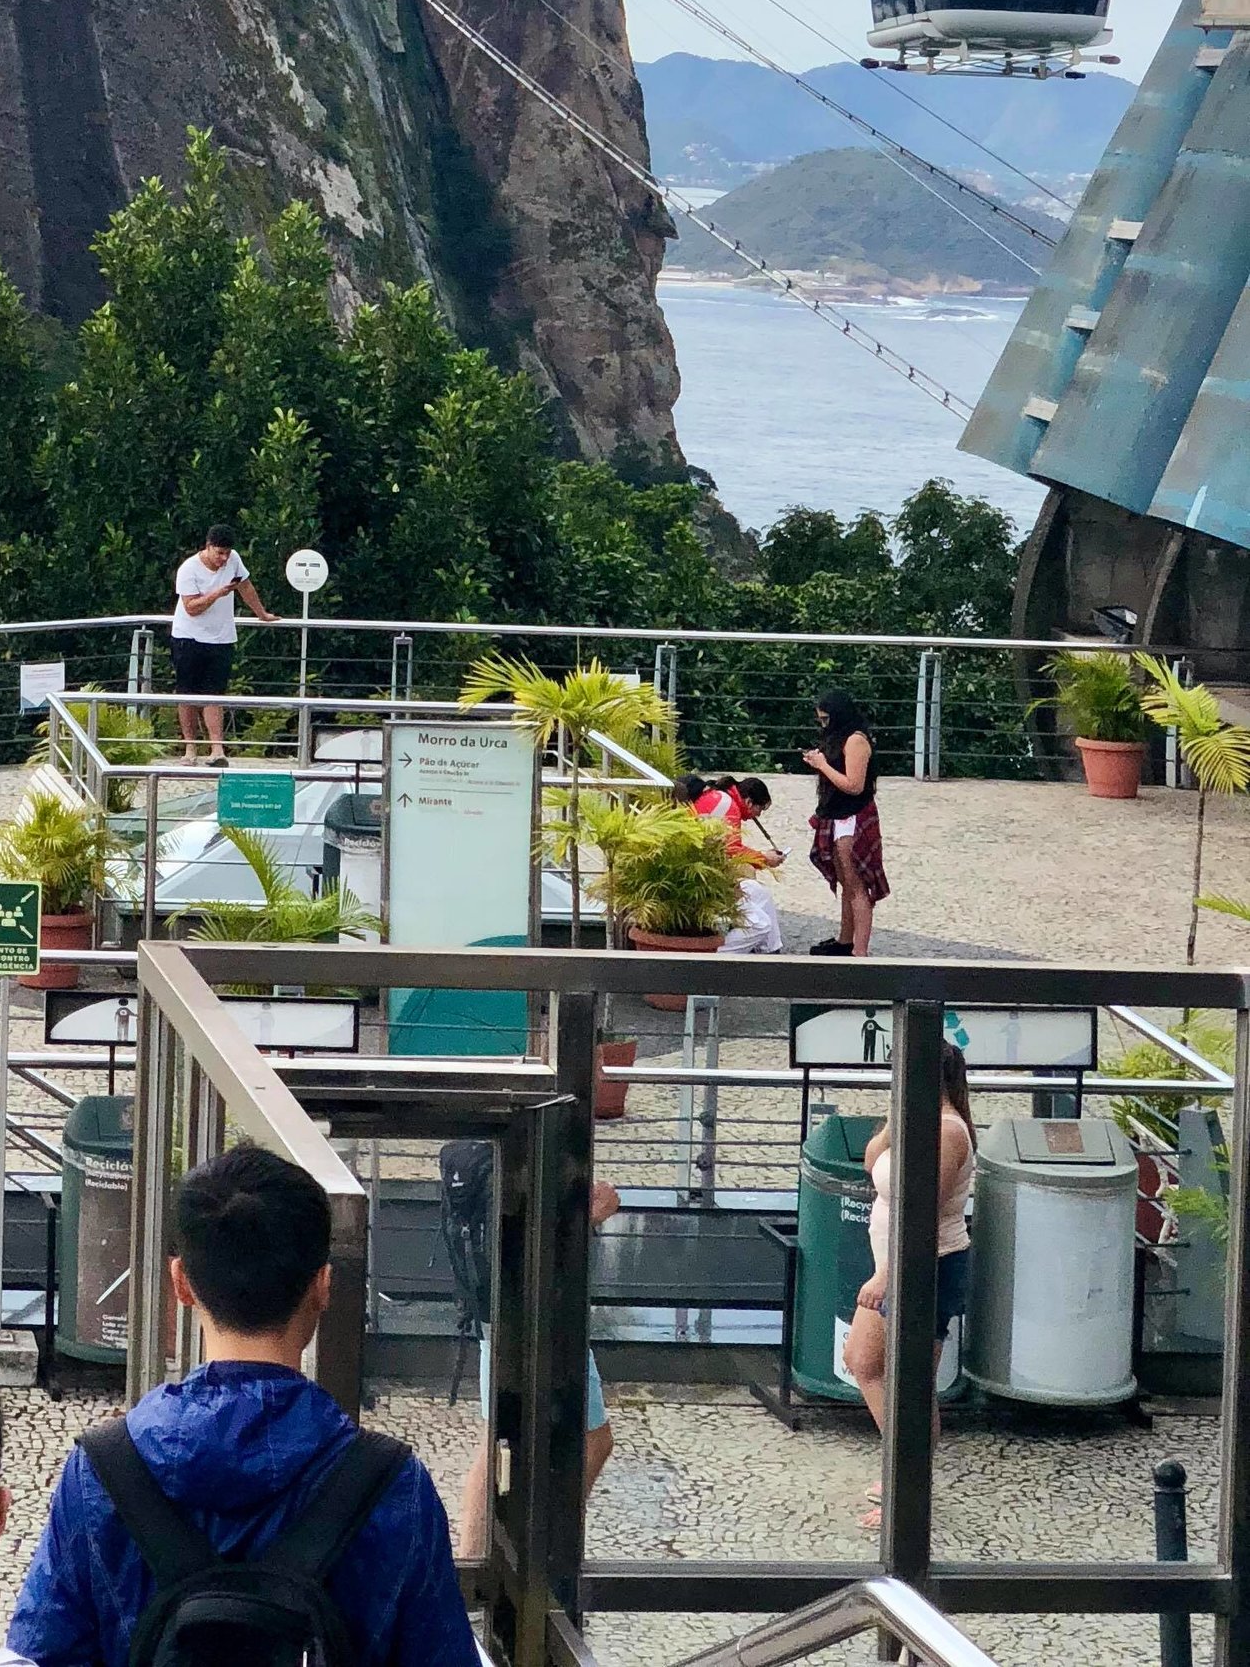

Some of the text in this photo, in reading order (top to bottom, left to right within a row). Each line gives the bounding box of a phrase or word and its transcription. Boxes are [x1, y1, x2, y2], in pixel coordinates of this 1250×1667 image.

[418, 733, 508, 749] Morro da Urca
[418, 797, 453, 807] Mirante
